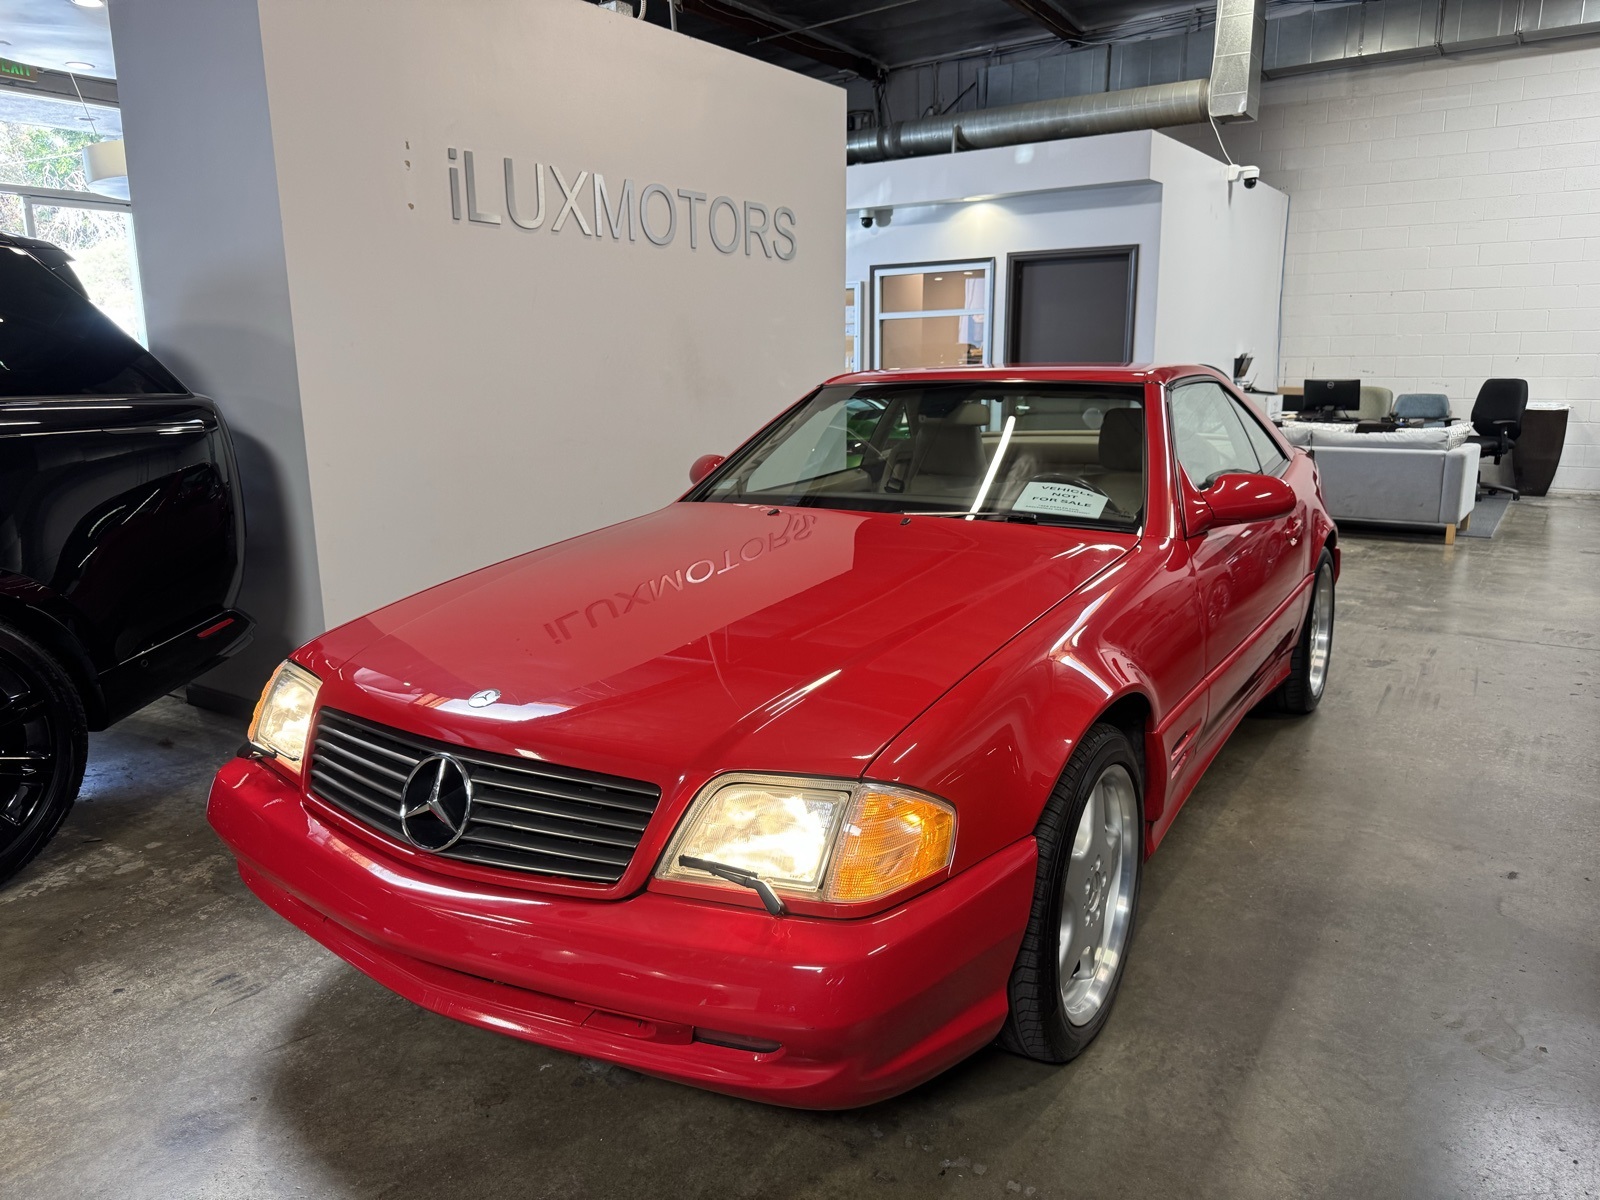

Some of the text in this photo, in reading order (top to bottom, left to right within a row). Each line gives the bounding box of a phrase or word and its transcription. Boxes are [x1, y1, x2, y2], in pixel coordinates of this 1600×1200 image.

[447, 147, 797, 261] iLUXMOTORS
[1041, 486, 1094, 497] VEHICLE
[1060, 499, 1092, 507] SALE
